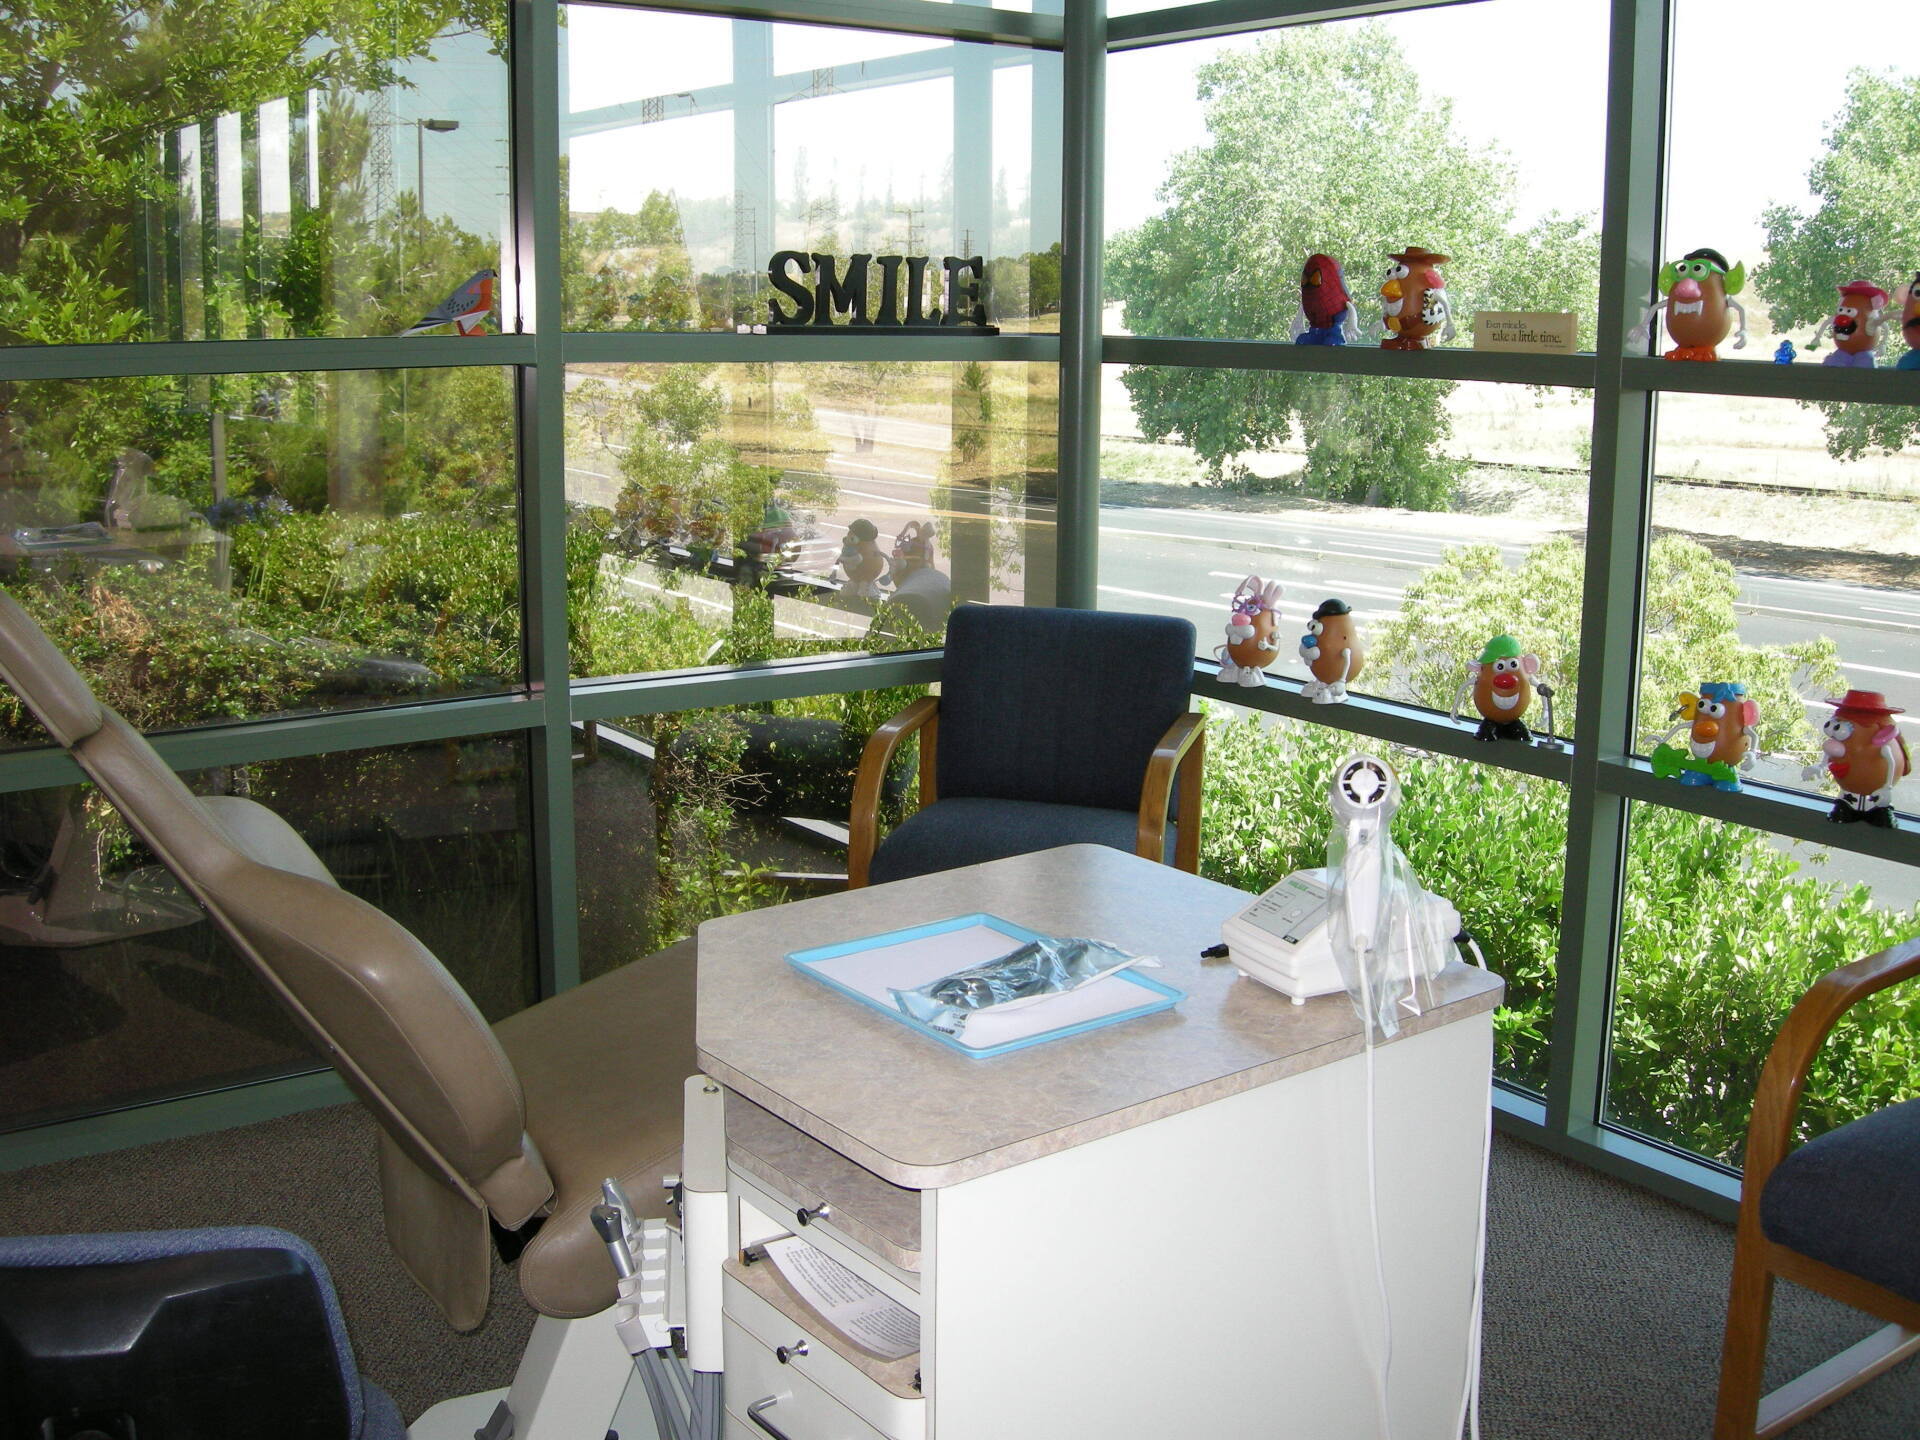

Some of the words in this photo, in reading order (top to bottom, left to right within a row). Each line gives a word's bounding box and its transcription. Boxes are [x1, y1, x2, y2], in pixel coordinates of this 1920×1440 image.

[768, 250, 988, 326] SMILE
[1486, 319, 1501, 329] Even
[1492, 329, 1510, 342] take
[1511, 334, 1517, 342] a
[1518, 329, 1538, 343] little
[1540, 330, 1562, 344] time.
